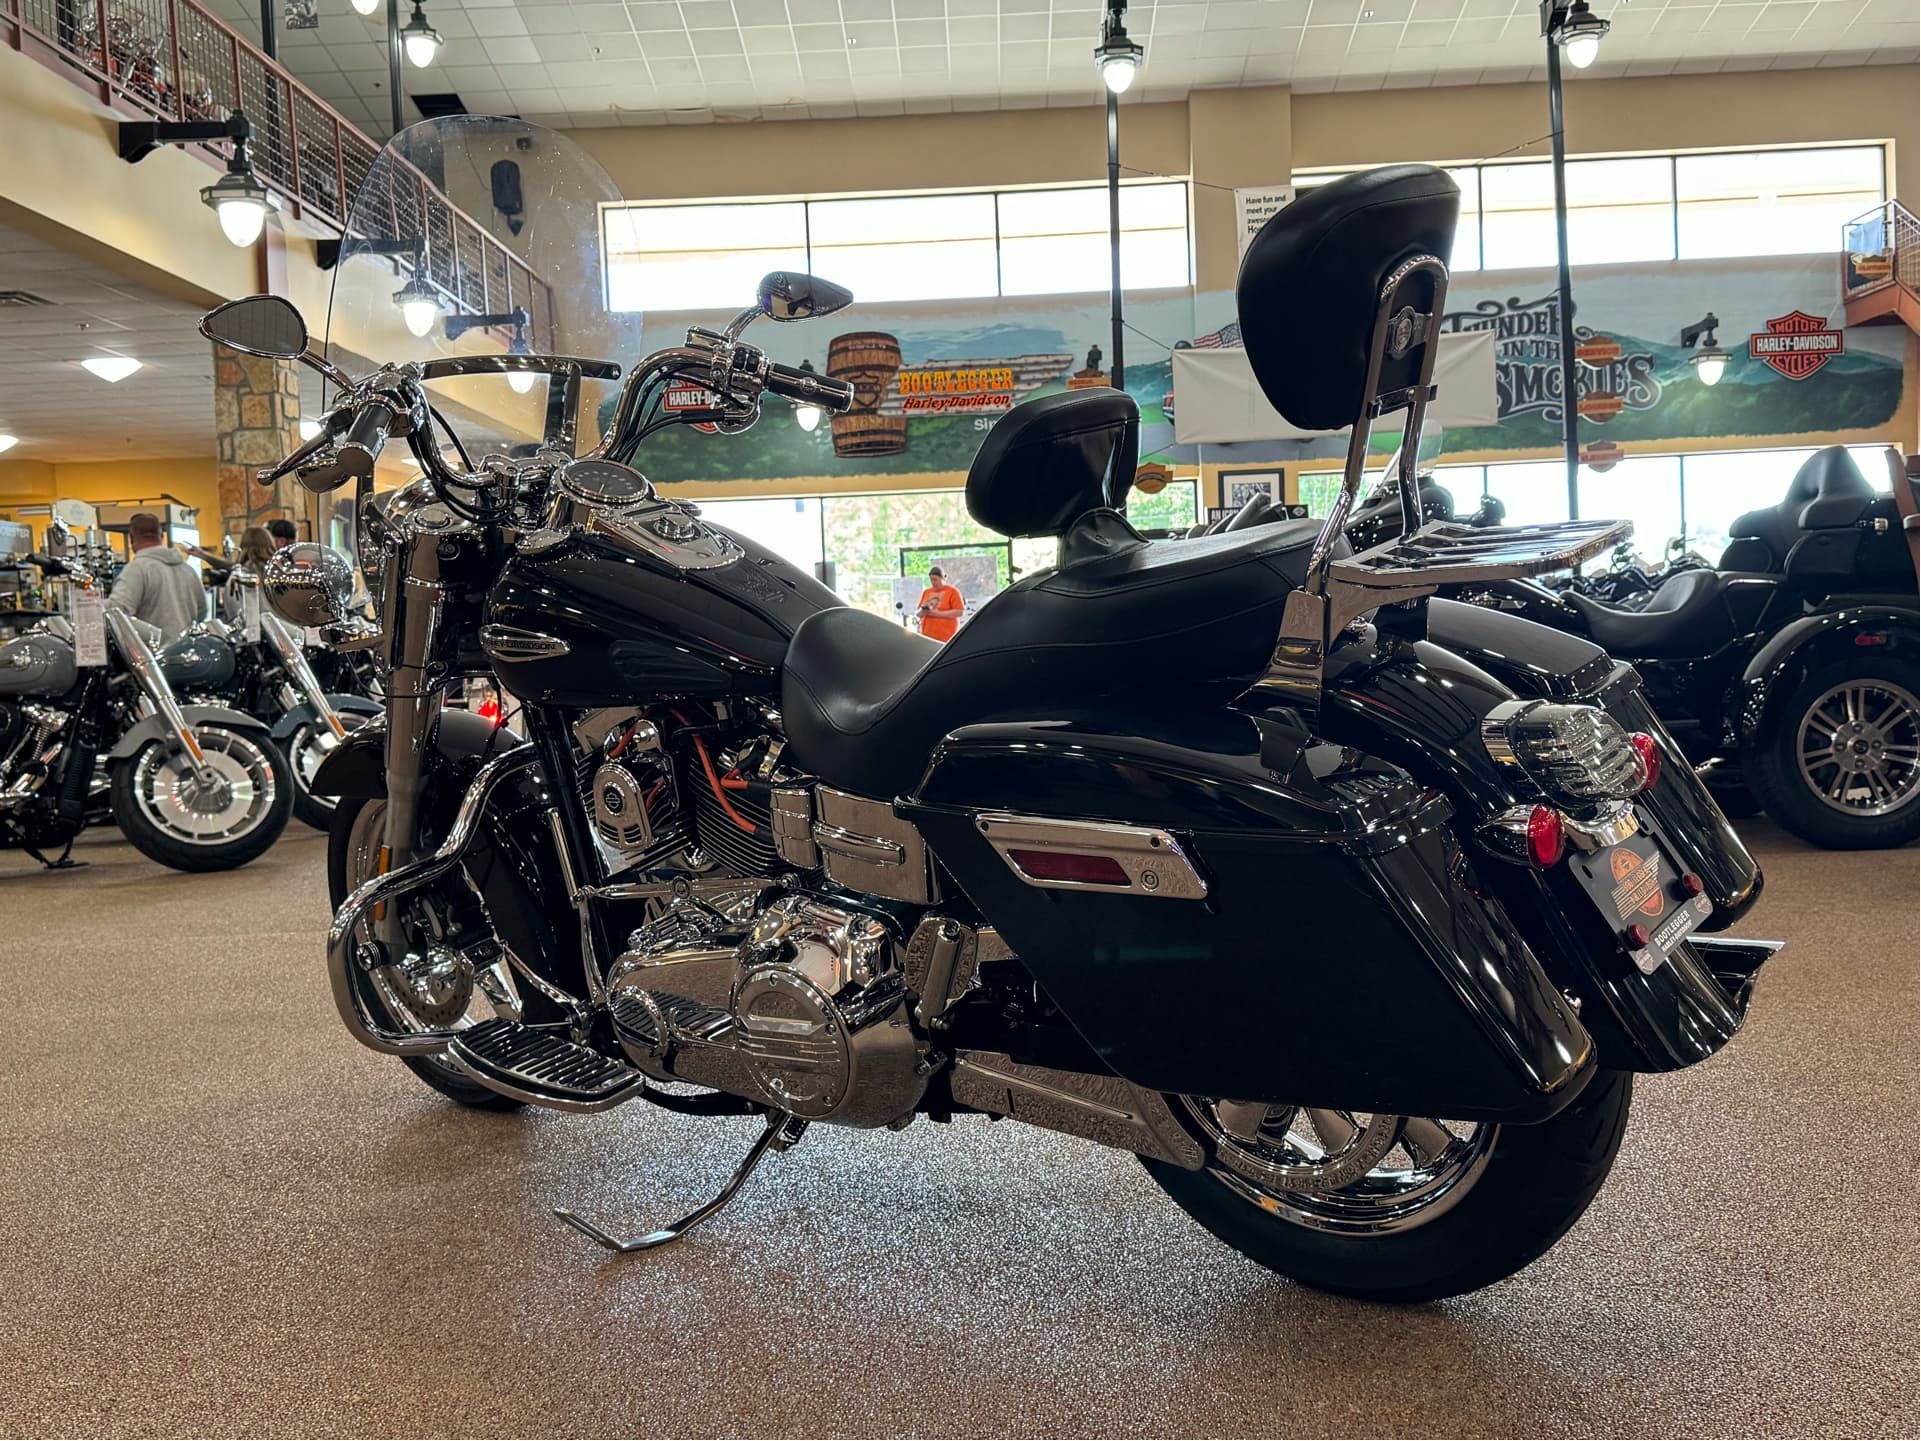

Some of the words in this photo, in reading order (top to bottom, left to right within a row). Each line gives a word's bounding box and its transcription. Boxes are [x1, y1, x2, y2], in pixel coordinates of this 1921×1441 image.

[1246, 196, 1261, 205] Have
[1263, 195, 1273, 203] fun
[1275, 194, 1286, 202] and
[1775, 317, 1819, 333] MOTOR
[1503, 341, 1524, 357] IN
[1530, 340, 1561, 361] TH
[1756, 334, 1838, 353] HARLEY-DAVIDSON
[1775, 354, 1819, 374] CYCLES
[899, 367, 1015, 395] BOOTLEGGER
[668, 390, 713, 406] HARLEY-D
[903, 394, 1011, 411] Harley-Davidson
[1654, 910, 1690, 946] BOOTLEGGER
